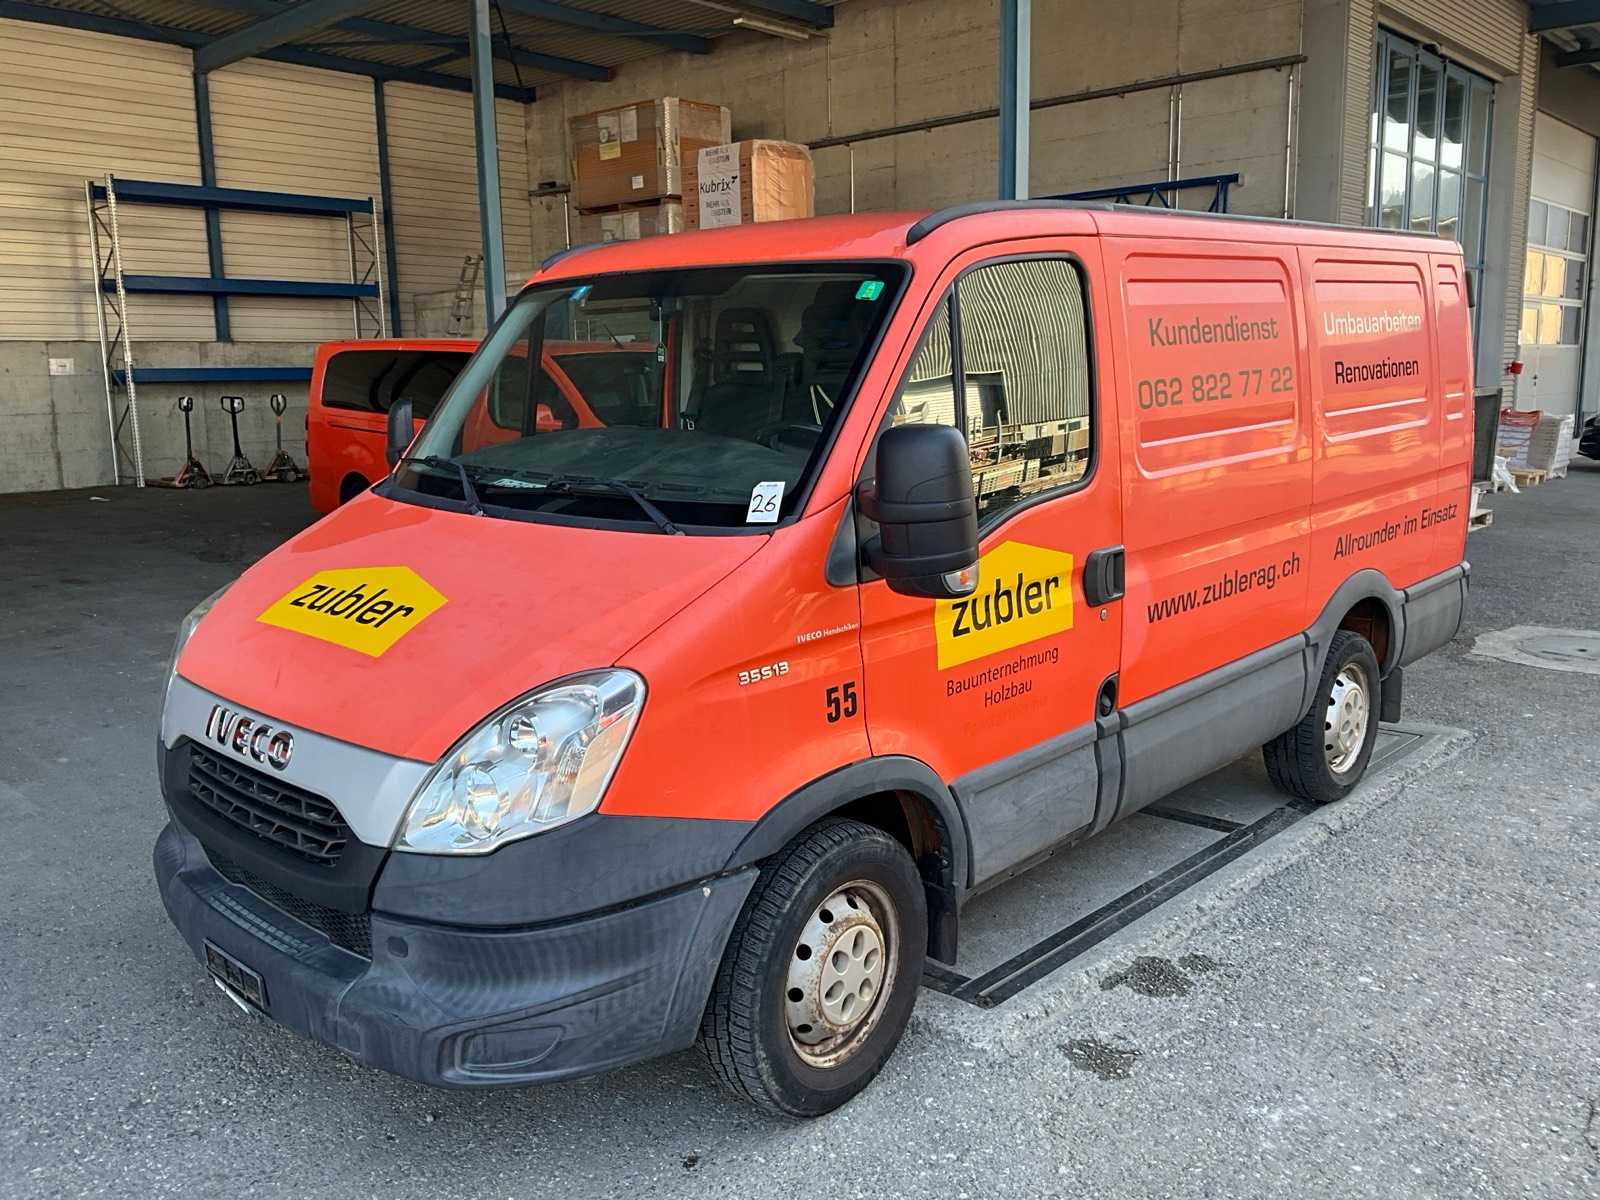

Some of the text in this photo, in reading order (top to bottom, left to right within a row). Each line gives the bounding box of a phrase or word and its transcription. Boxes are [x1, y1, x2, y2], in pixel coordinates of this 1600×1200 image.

[700, 178, 731, 194] Kubrix
[1149, 316, 1279, 347] Kundendienst
[1323, 310, 1421, 336] Umbauarbeiten
[1138, 366, 1294, 410] 062 822 77 22
[1335, 356, 1420, 385] Renovationen
[752, 494, 777, 513] 26
[1333, 503, 1458, 561] Allrounder im Einsatz
[290, 583, 415, 629] zubler
[952, 572, 1060, 638] zubler
[1147, 552, 1301, 624] www.zublerag.ch
[797, 630, 823, 644] IVECO
[738, 660, 790, 686] 35S13
[946, 647, 1059, 697] Bauunternehmung
[825, 681, 858, 724] 55
[984, 680, 1033, 708] Holzbau
[205, 703, 296, 771] IVECO
